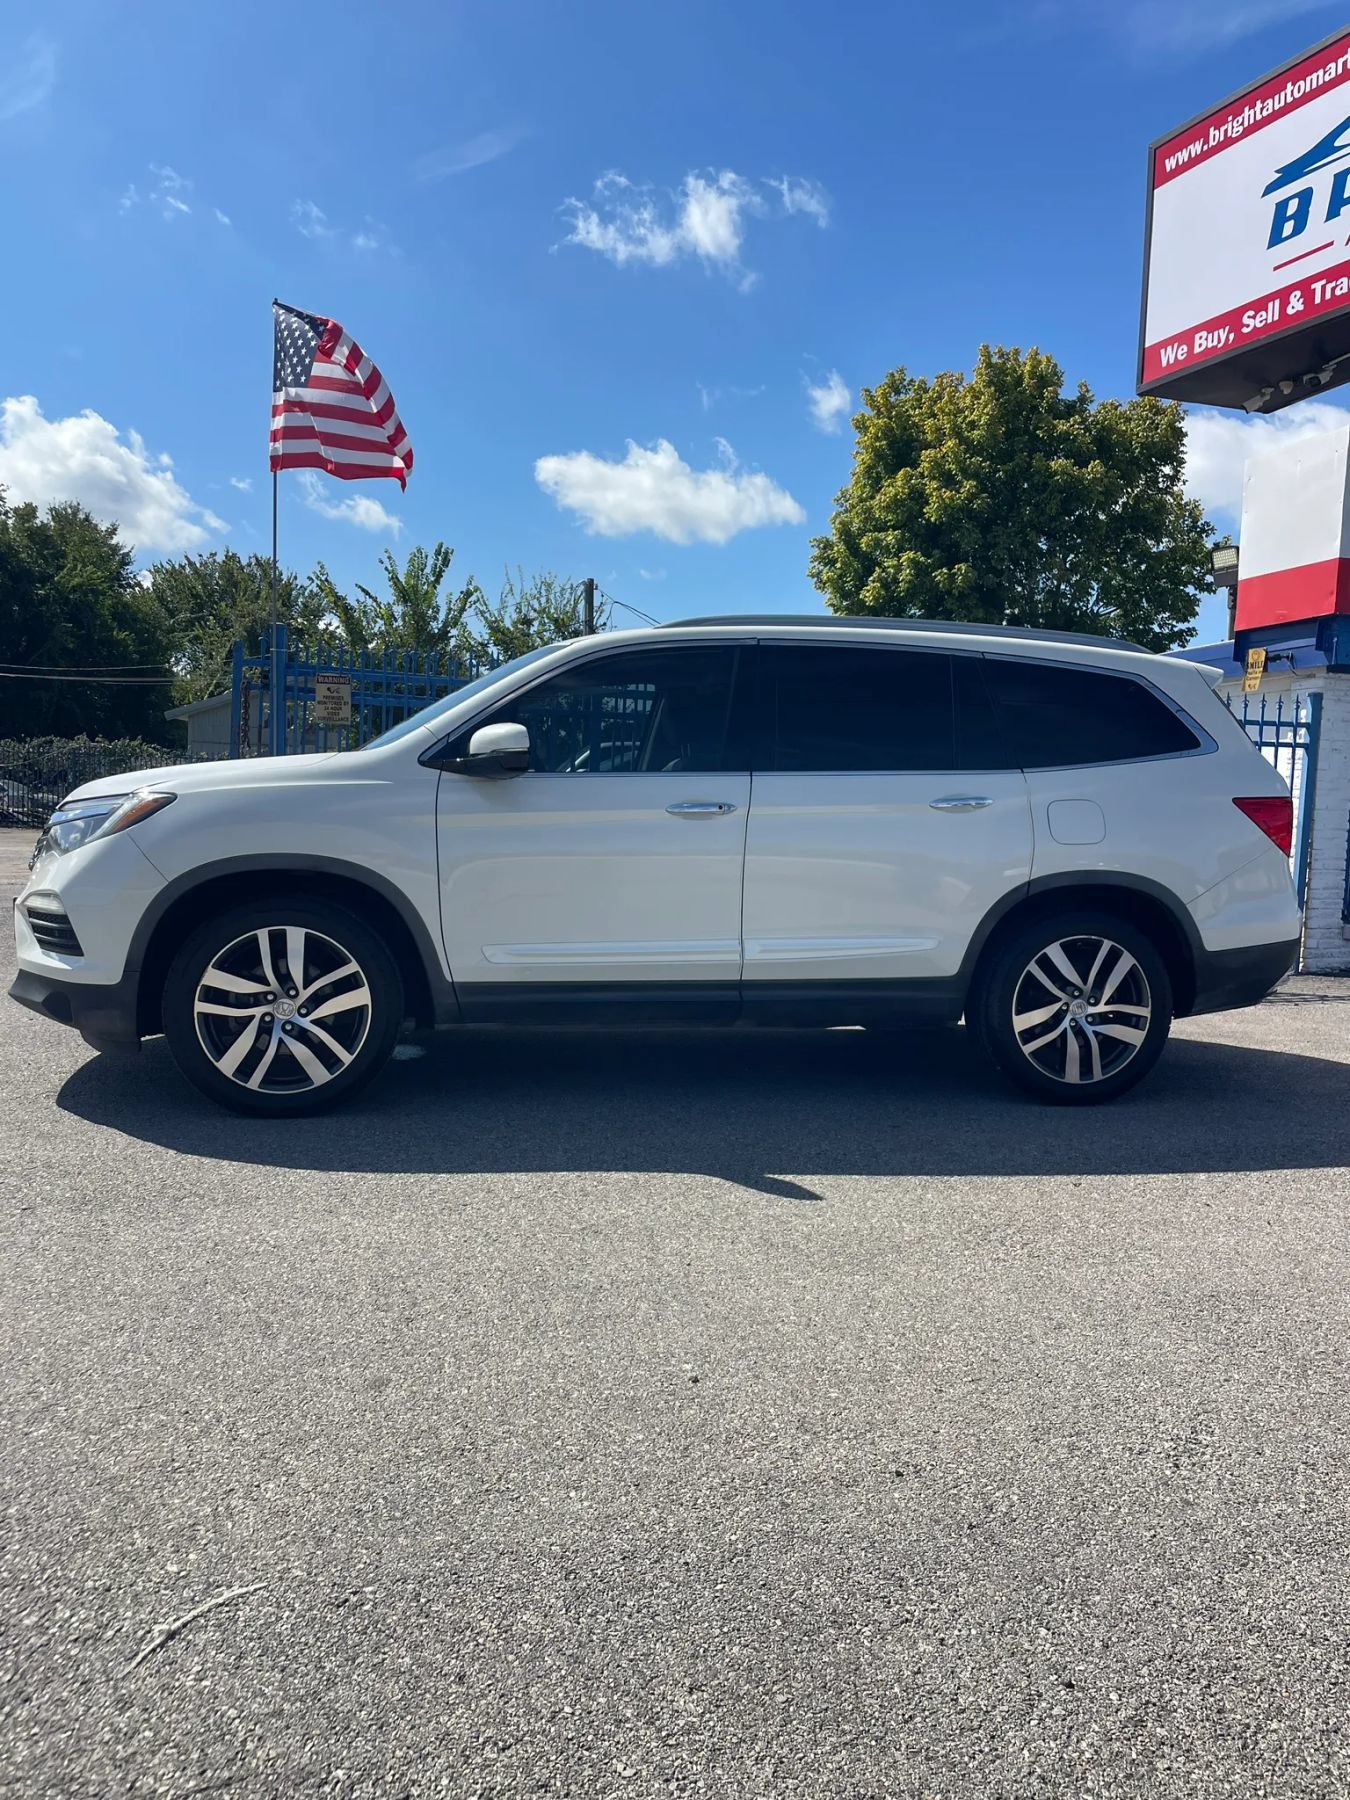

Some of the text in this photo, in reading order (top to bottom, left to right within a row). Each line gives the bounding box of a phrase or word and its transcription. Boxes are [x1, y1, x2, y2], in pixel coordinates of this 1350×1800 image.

[1159, 275, 1350, 368] We Buy, Sell & Tra
[318, 676, 350, 684] WARNING
